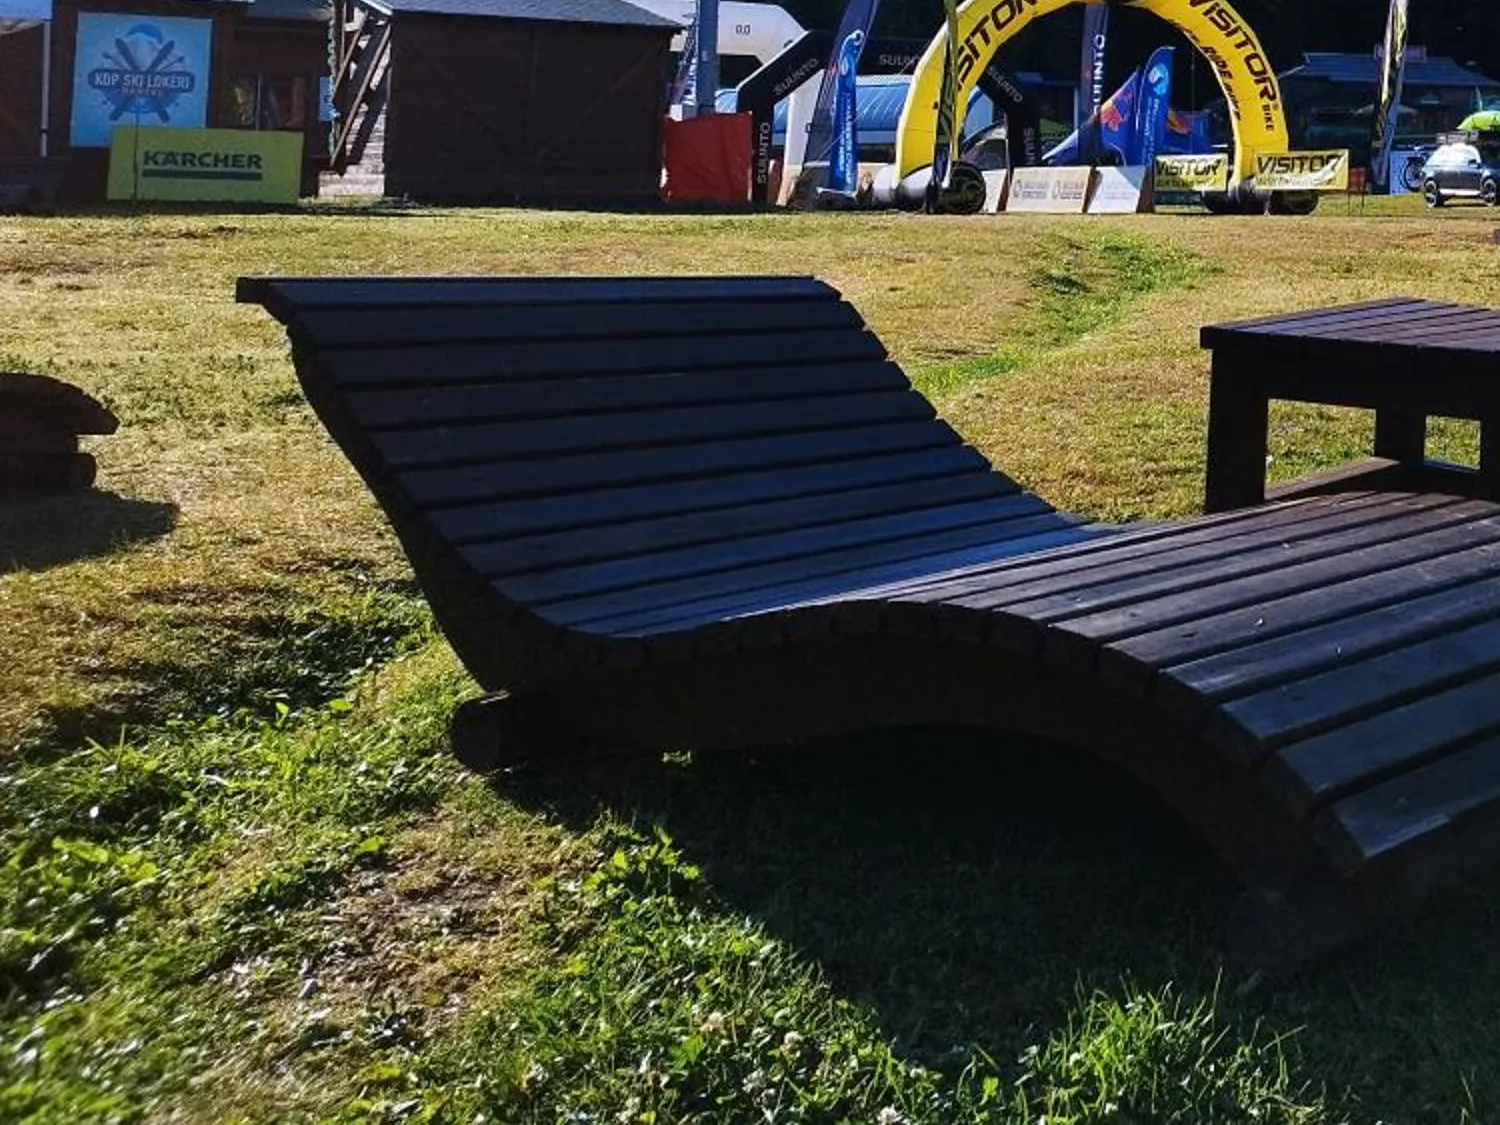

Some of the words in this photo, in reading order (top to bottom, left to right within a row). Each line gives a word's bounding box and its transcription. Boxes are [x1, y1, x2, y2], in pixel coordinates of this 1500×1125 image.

[1262, 104, 1275, 131] BIKE
[142, 149, 264, 170] KÄRCHER
[756, 121, 771, 185] SUUNTO
[1023, 126, 1036, 166] SUUN
[1155, 158, 1222, 176] VISITOR
